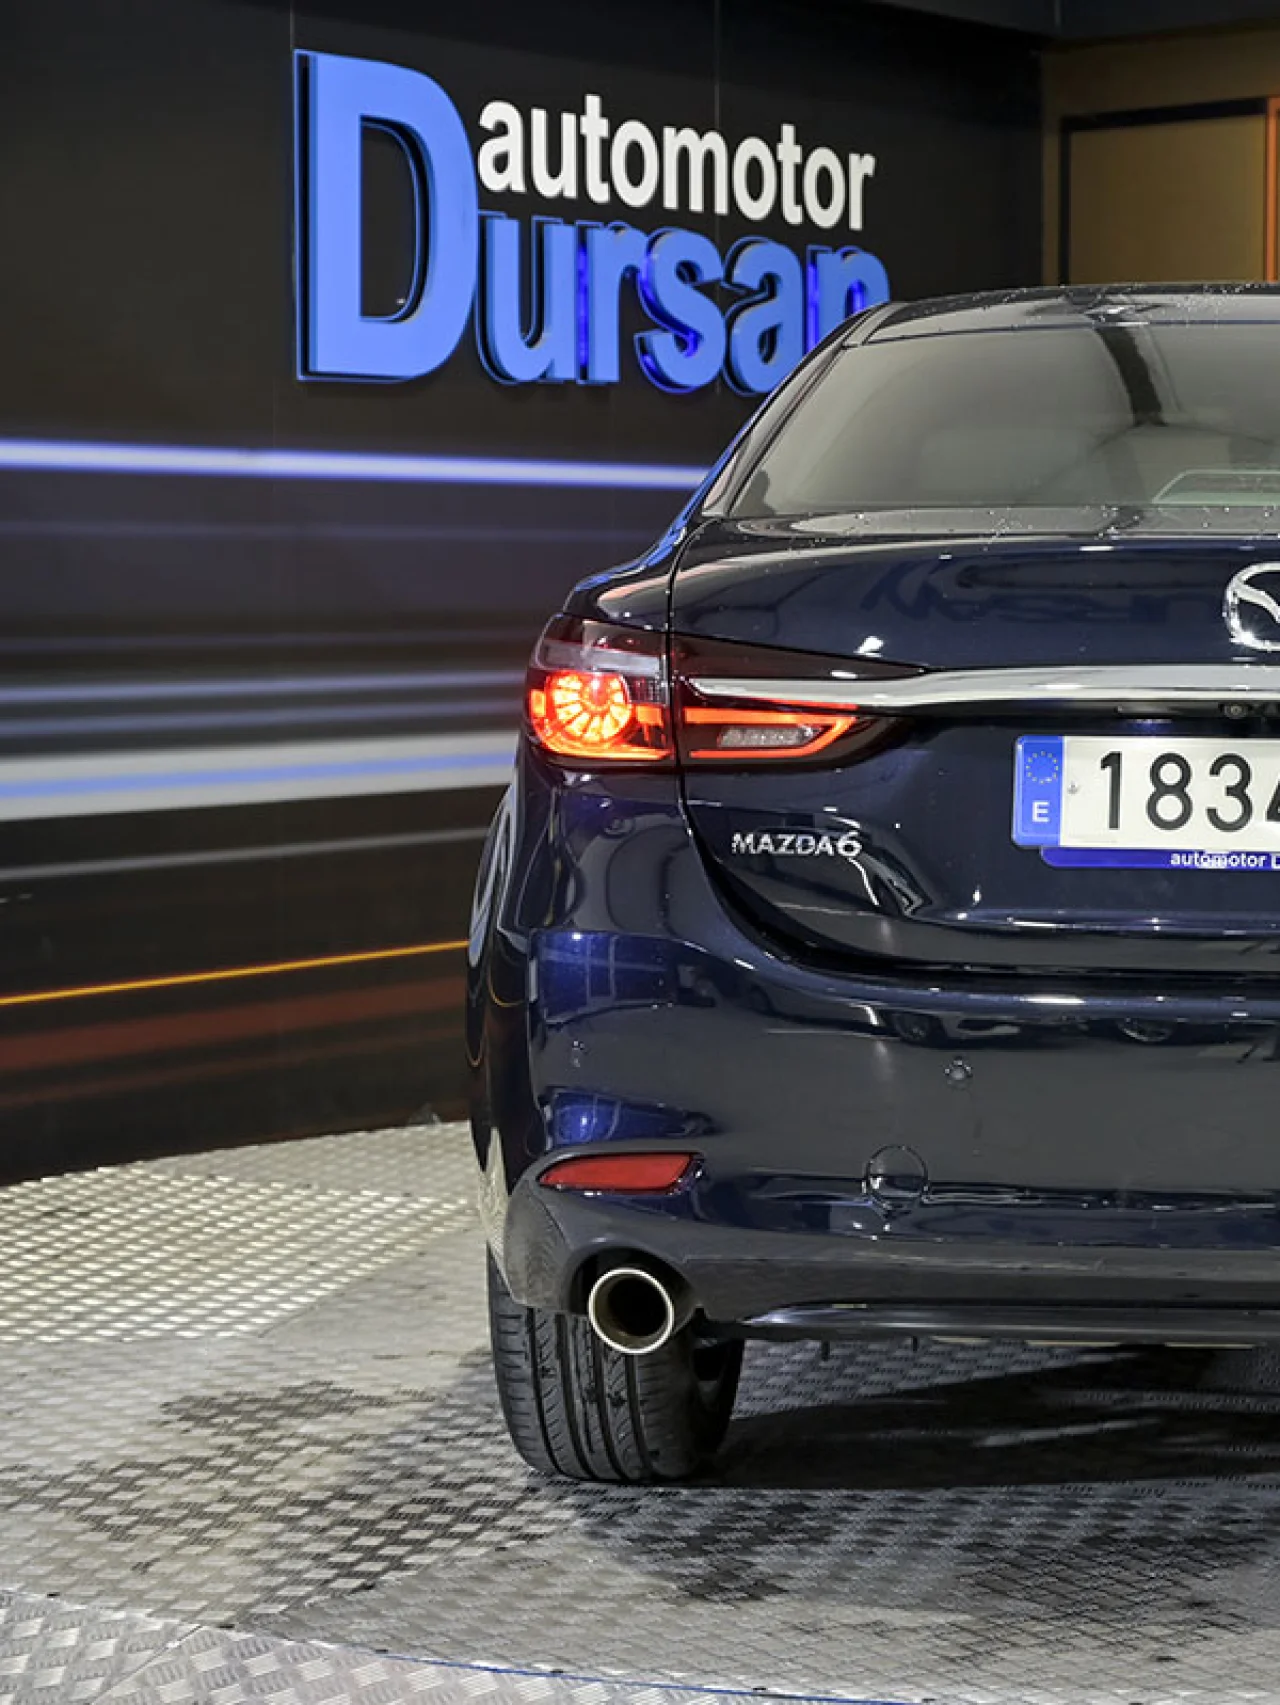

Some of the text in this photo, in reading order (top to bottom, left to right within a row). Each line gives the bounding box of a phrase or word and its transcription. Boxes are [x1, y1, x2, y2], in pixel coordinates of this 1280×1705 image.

[477, 94, 875, 230] automotor
[1031, 801, 1050, 824] E
[1170, 852, 1267, 869] automotor
